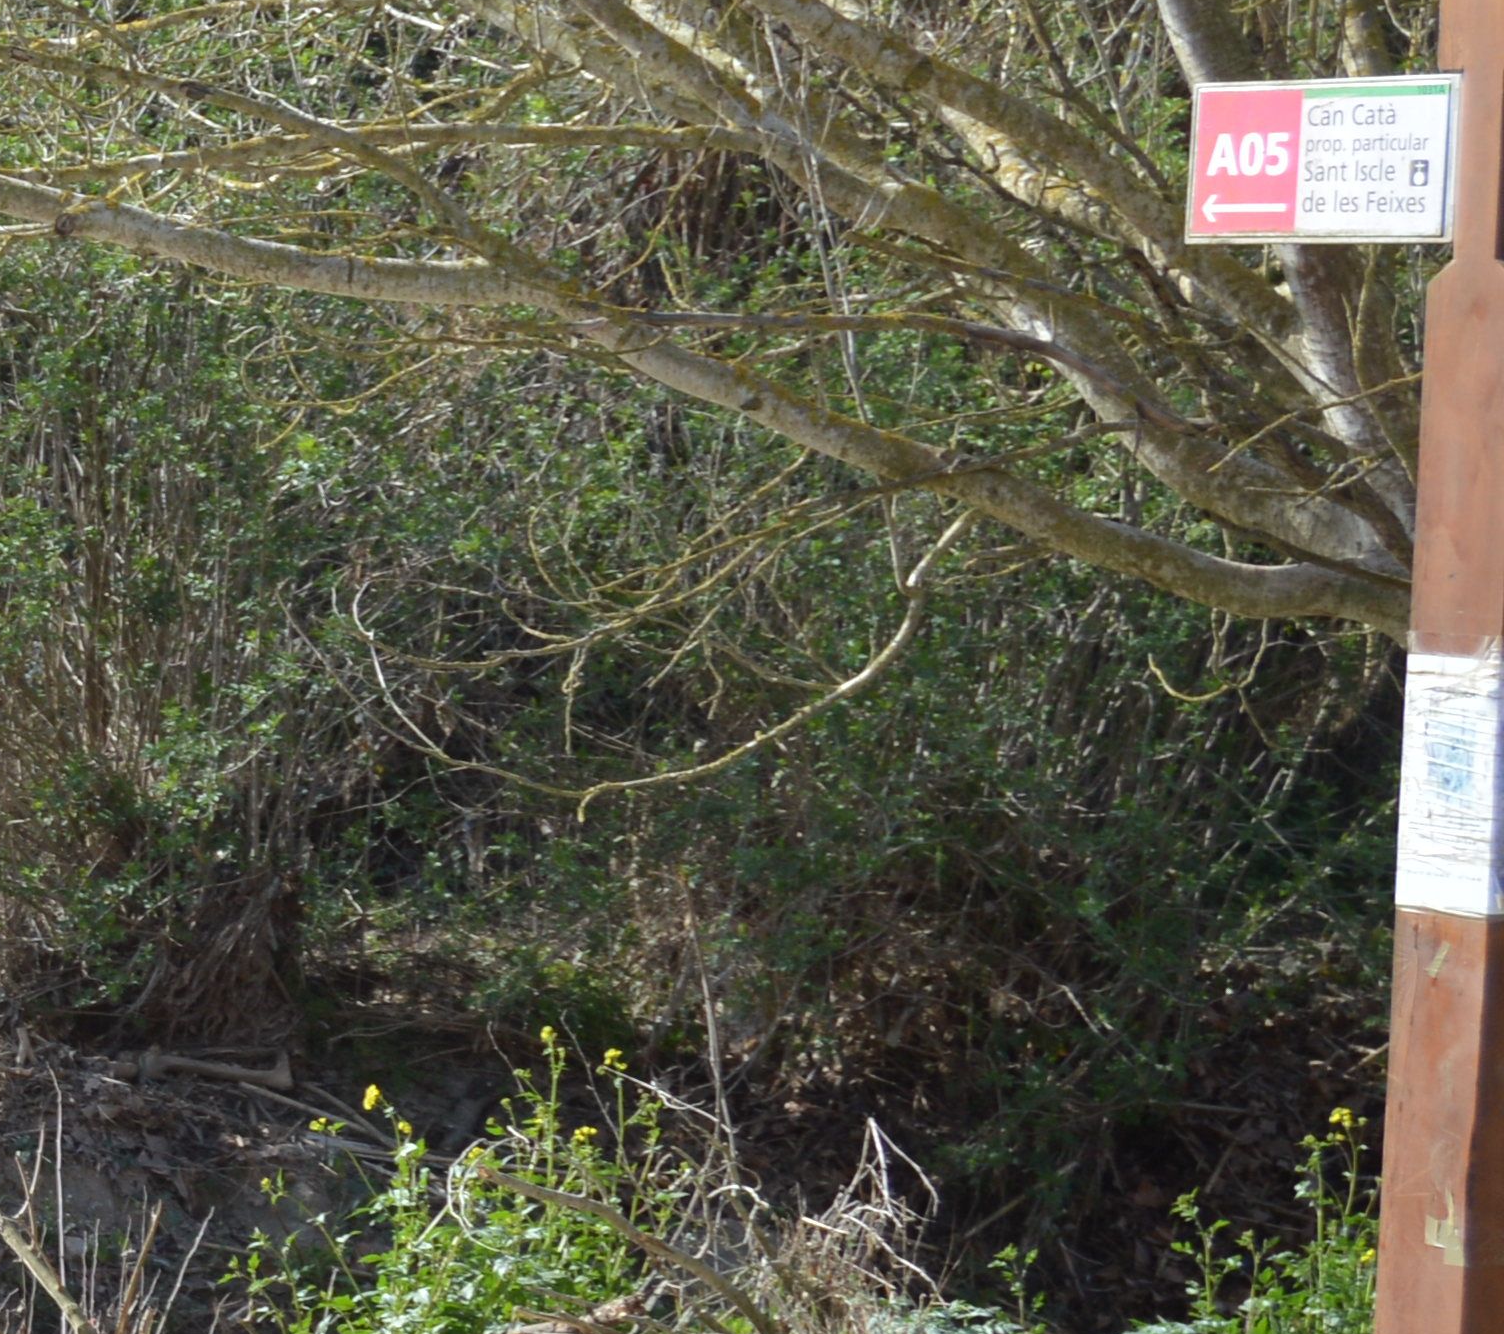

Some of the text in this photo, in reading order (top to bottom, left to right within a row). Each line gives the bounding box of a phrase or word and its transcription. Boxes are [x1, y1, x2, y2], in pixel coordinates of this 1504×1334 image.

[1307, 102, 1396, 127] Can Catà
[1206, 132, 1289, 177] A05
[1305, 133, 1429, 156] prop. particular
[1303, 158, 1396, 182] Sant Iscle
[1302, 190, 1426, 213] de les Feixes
